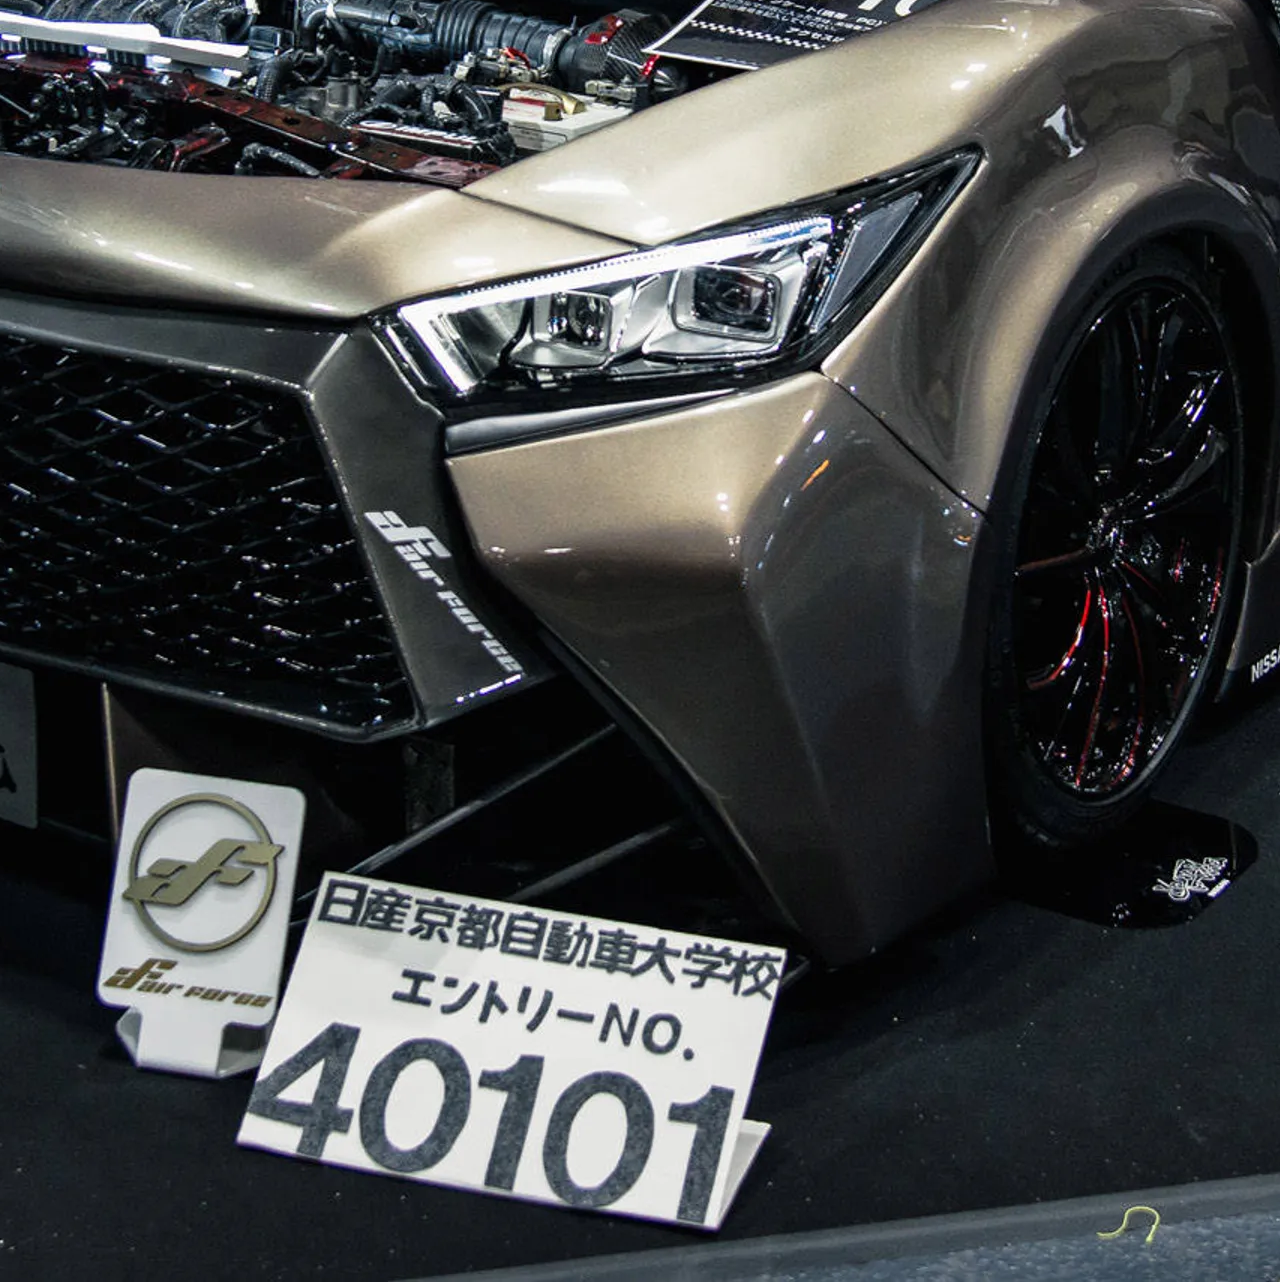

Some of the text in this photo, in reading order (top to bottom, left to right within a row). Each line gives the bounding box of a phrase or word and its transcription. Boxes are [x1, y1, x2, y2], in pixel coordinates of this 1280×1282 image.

[317, 877, 784, 1003] 日産京都自動車大学校
[392, 967, 697, 1062] エントリーNO.
[246, 1021, 736, 1227] 40101
